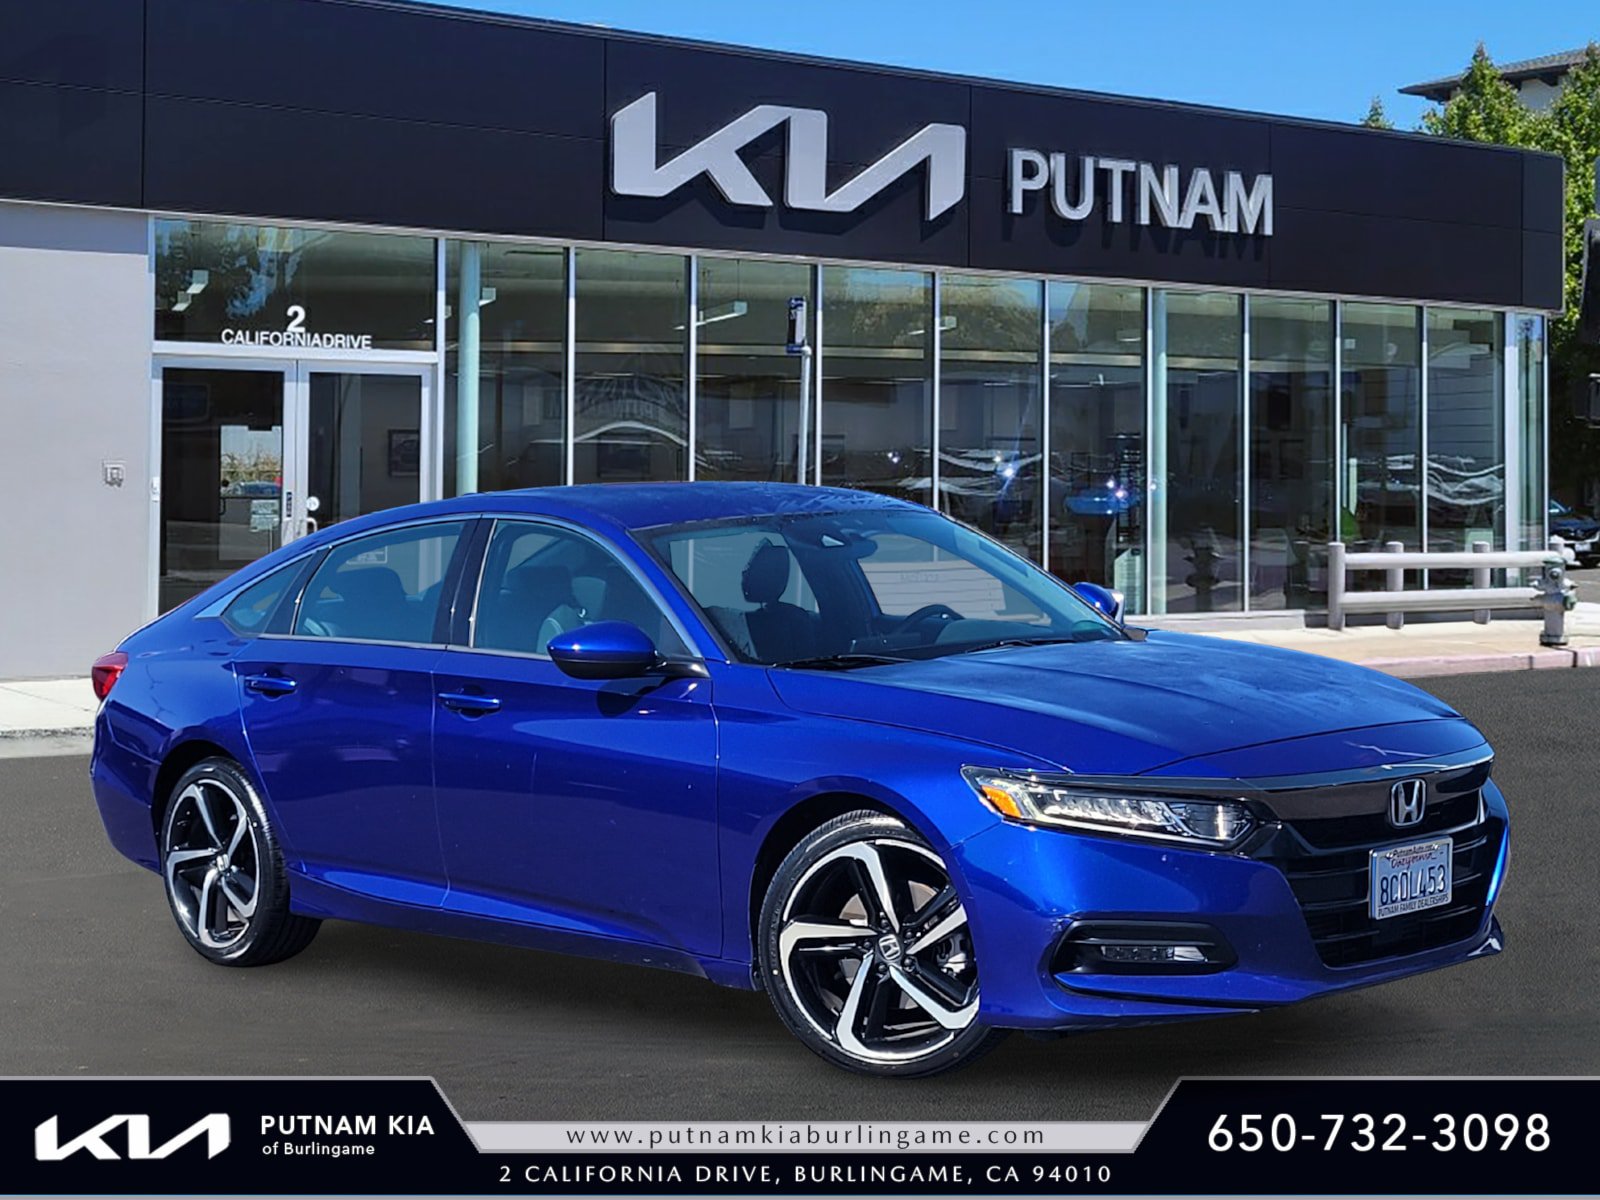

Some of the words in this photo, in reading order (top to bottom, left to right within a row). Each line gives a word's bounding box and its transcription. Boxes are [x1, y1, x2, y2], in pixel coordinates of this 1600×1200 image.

[610, 91, 966, 221] KIA
[1008, 148, 1273, 236] PUTNAM
[286, 305, 306, 333] 2
